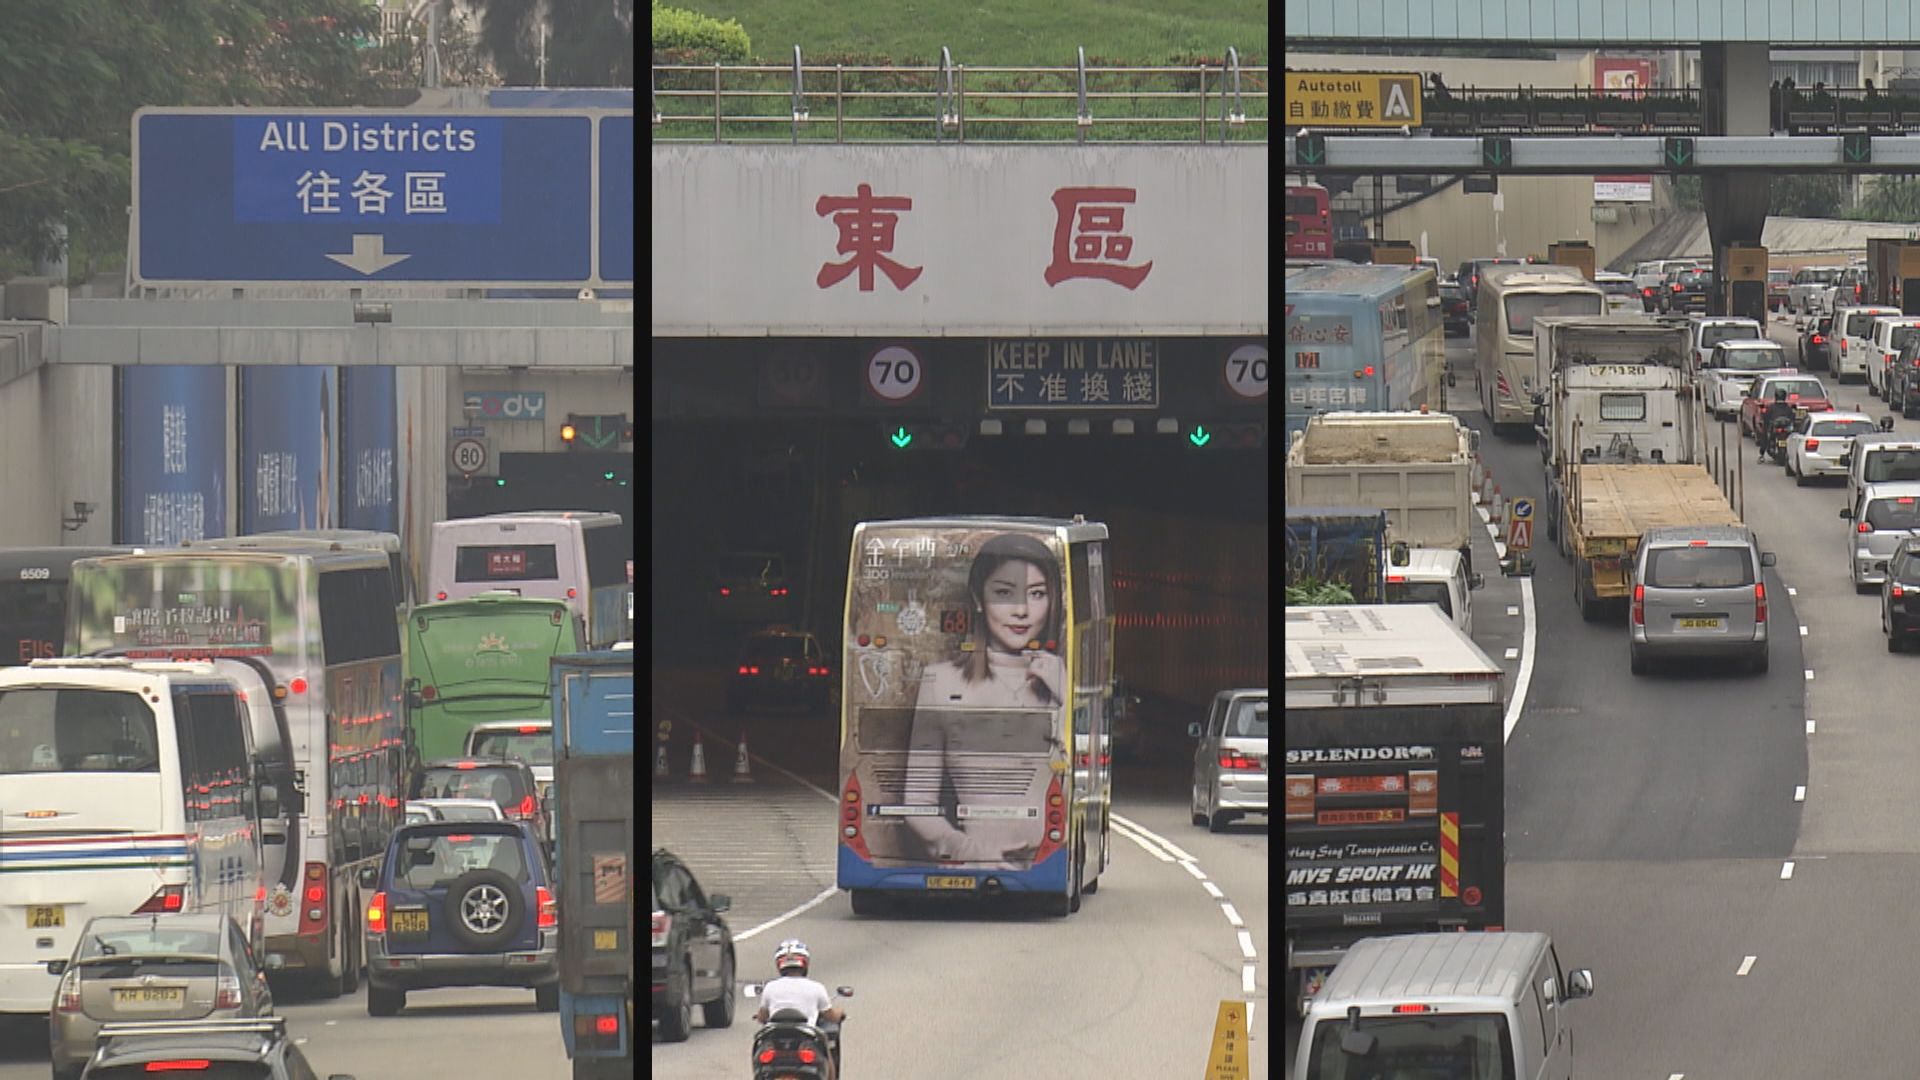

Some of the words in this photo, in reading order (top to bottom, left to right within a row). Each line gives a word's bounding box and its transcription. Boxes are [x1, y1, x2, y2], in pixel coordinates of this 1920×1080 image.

[1297, 79, 1362, 93] Autotoll
[1289, 101, 1374, 118] 自動繳費
[259, 121, 309, 151] All
[323, 121, 477, 152] Districts
[297, 169, 448, 215] 往各區
[815, 183, 1153, 292] 東區
[993, 341, 1050, 369] KEEP
[1063, 341, 1084, 369] IN
[1097, 341, 1153, 369] LANE
[875, 362, 915, 384] 70
[1232, 359, 1268, 382] 70
[461, 448, 479, 465] 80
[20, 568, 50, 579] 6509
[1335, 865, 1403, 883] SPORT
[1405, 863, 1436, 880] HK
